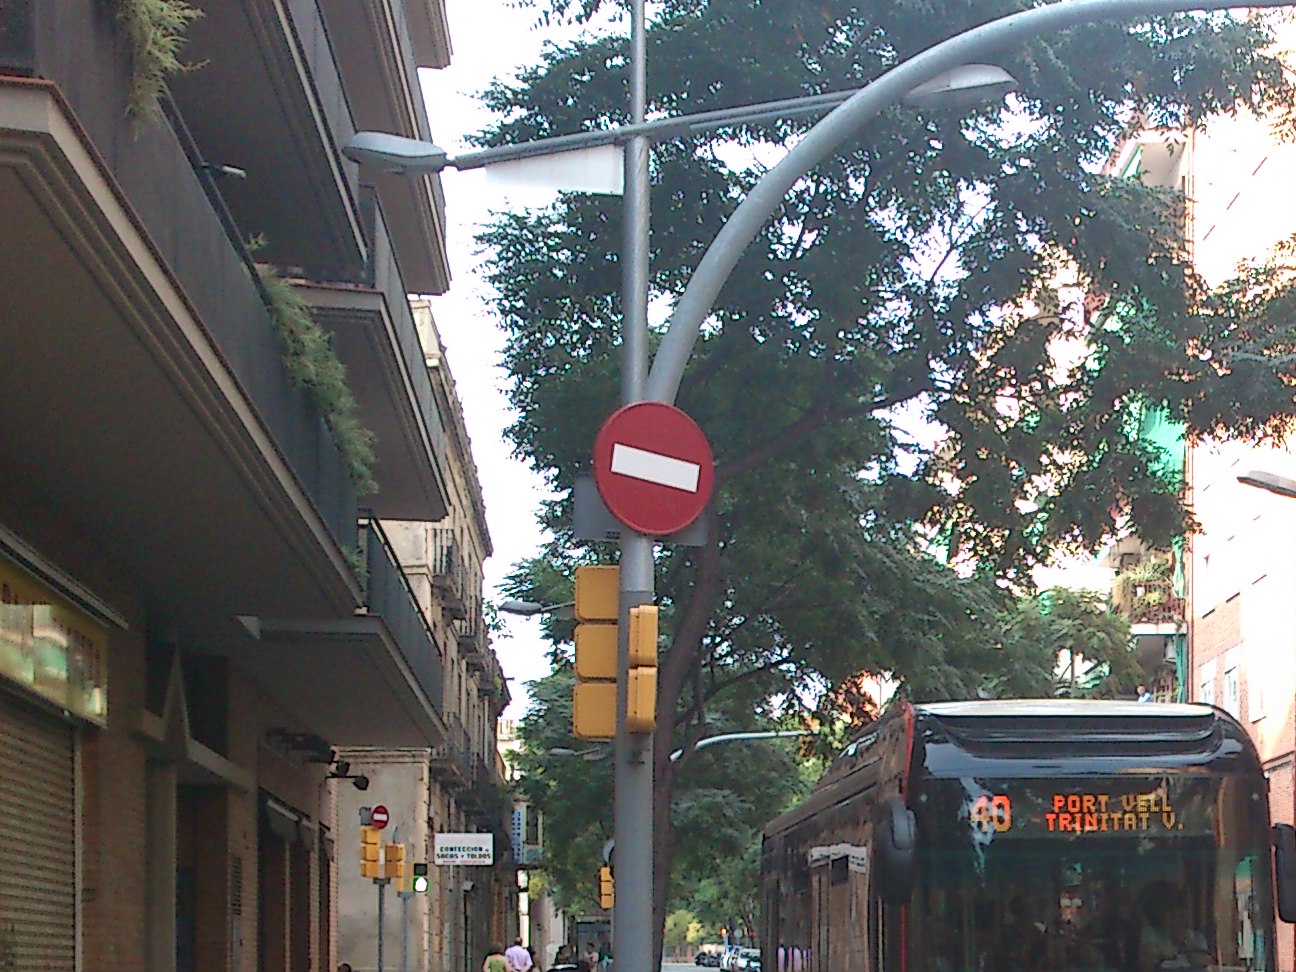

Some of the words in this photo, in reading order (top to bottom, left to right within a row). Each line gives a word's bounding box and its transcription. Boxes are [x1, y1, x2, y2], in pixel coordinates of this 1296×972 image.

[970, 793, 1012, 832] 40
[1053, 794, 1109, 813] PORT
[1121, 794, 1173, 812] VELL
[1045, 812, 1150, 832] TRINITAT
[1161, 812, 1184, 831] V.
